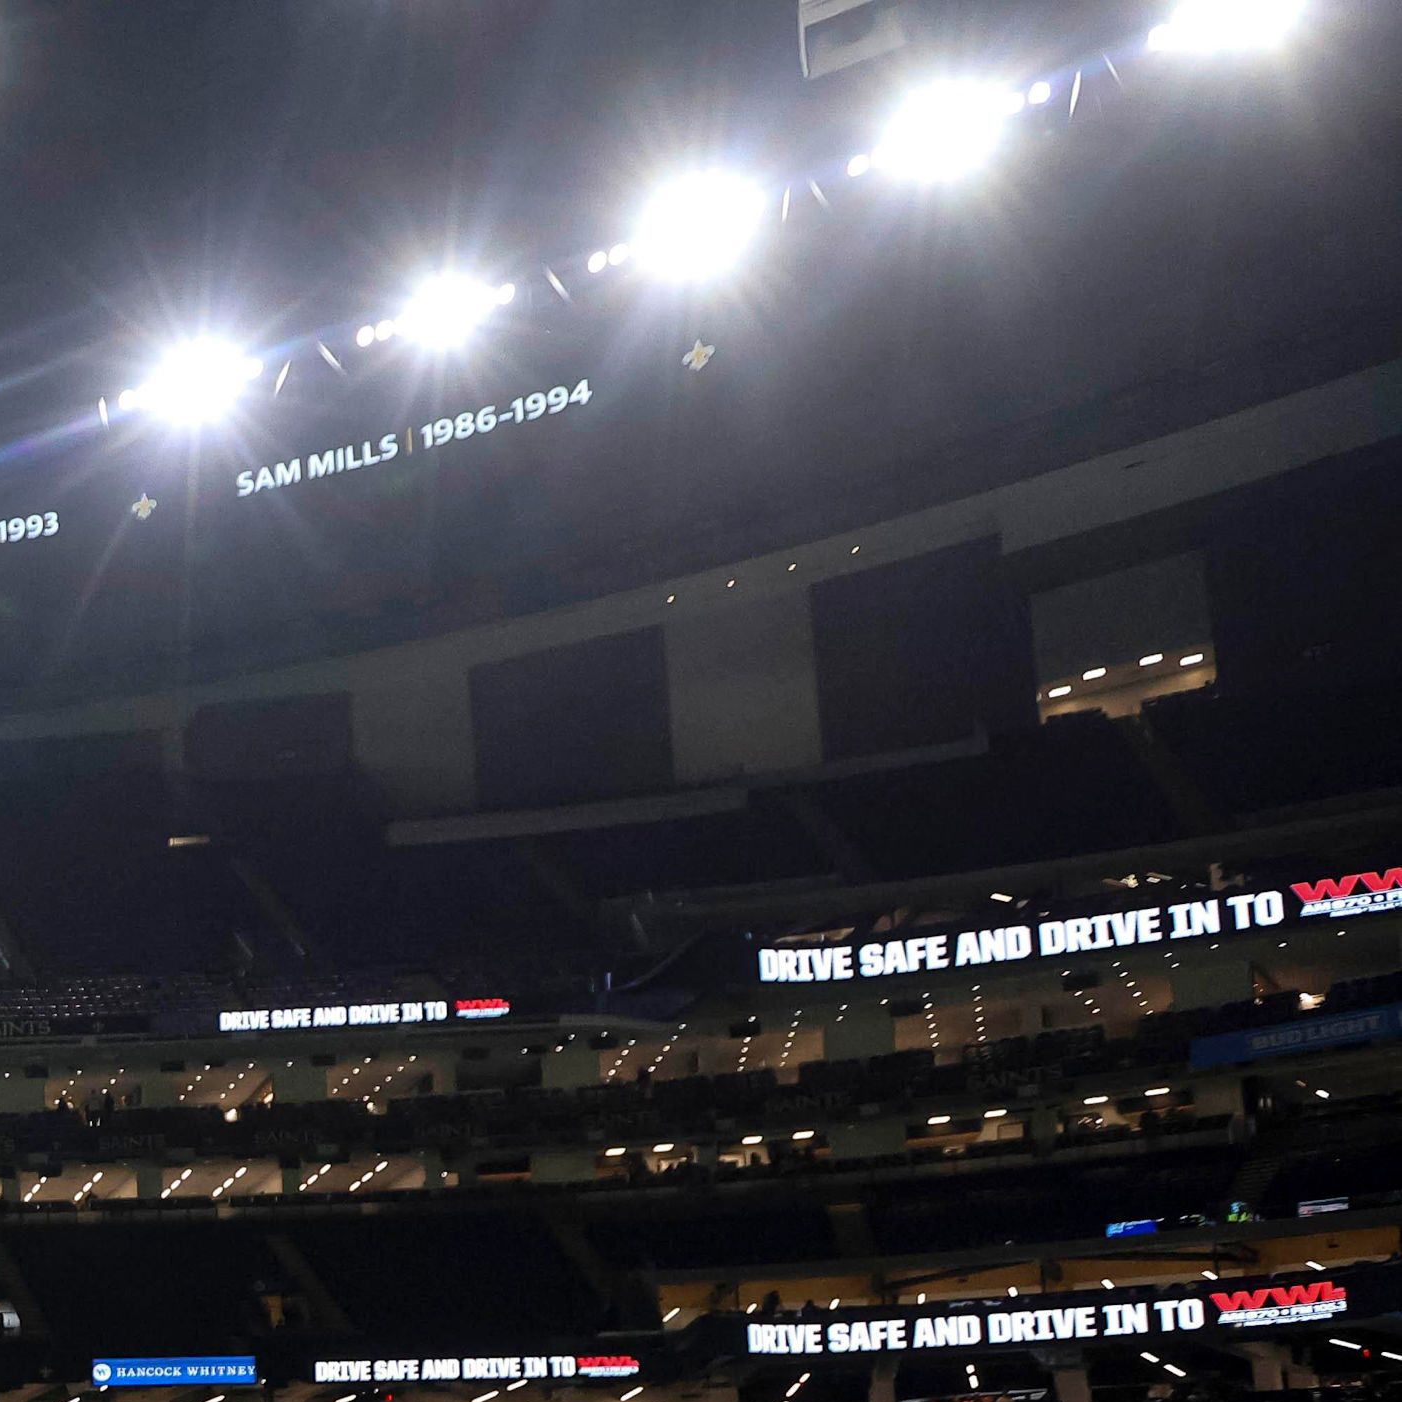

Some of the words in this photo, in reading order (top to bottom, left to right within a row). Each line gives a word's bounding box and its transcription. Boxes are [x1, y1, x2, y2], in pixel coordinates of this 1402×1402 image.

[236, 457, 301, 497] SAM
[308, 433, 398, 480] MILLS
[421, 379, 593, 449] 1986-1994
[758, 945, 854, 982] DRIVE
[859, 934, 950, 977] SAFE
[955, 925, 1032, 967] AND
[1038, 907, 1163, 956] DRIVE
[1167, 898, 1221, 939] IN
[1226, 890, 1285, 930] TO
[1289, 867, 1402, 902] WW
[219, 1009, 270, 1032] DRIVE
[270, 1007, 312, 1029] SAFE
[312, 1006, 348, 1027] AND
[348, 1003, 401, 1025] DRIVE
[400, 1002, 424, 1023] IN
[423, 1000, 448, 1022] TO
[747, 1323, 823, 1354] DRIVE
[827, 1319, 908, 1353] SAFE
[912, 1314, 982, 1349] AND
[987, 1306, 1098, 1344] DRIVE
[1102, 1301, 1159, 1336] IN
[1158, 1298, 1205, 1332] TO
[116, 1366, 181, 1377] HANCOCK
[187, 1365, 256, 1376] WHITNEY
[314, 1360, 372, 1382] DRIVE
[373, 1359, 420, 1381] SAFE
[421, 1358, 461, 1380] AND
[462, 1357, 523, 1379] DRIVE
[520, 1356, 548, 1378] IN
[548, 1355, 577, 1378] TO
